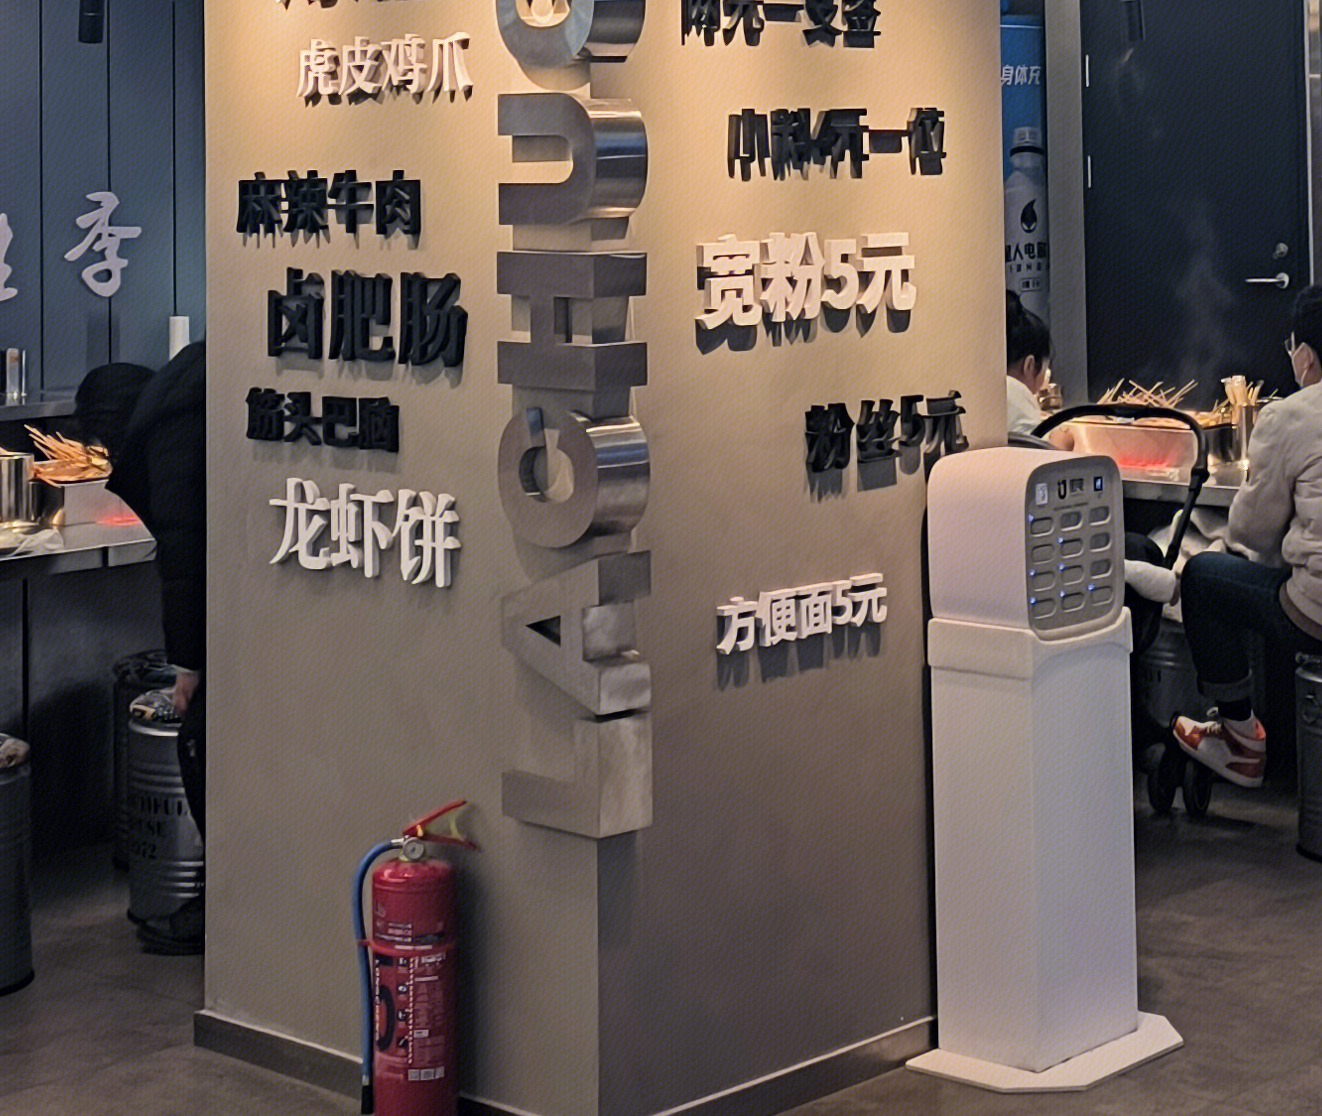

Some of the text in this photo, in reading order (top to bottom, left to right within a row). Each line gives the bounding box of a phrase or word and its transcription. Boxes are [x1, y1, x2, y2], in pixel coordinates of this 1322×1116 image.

[297, 31, 474, 99] 虎皮鸡爪
[237, 169, 421, 240] 麻辣牛肉
[267, 266, 469, 370] 卤肥肠
[695, 232, 917, 332] 宽粉5元
[269, 477, 462, 588] 龙虾饼
[716, 572, 888, 656] 方便面5元
